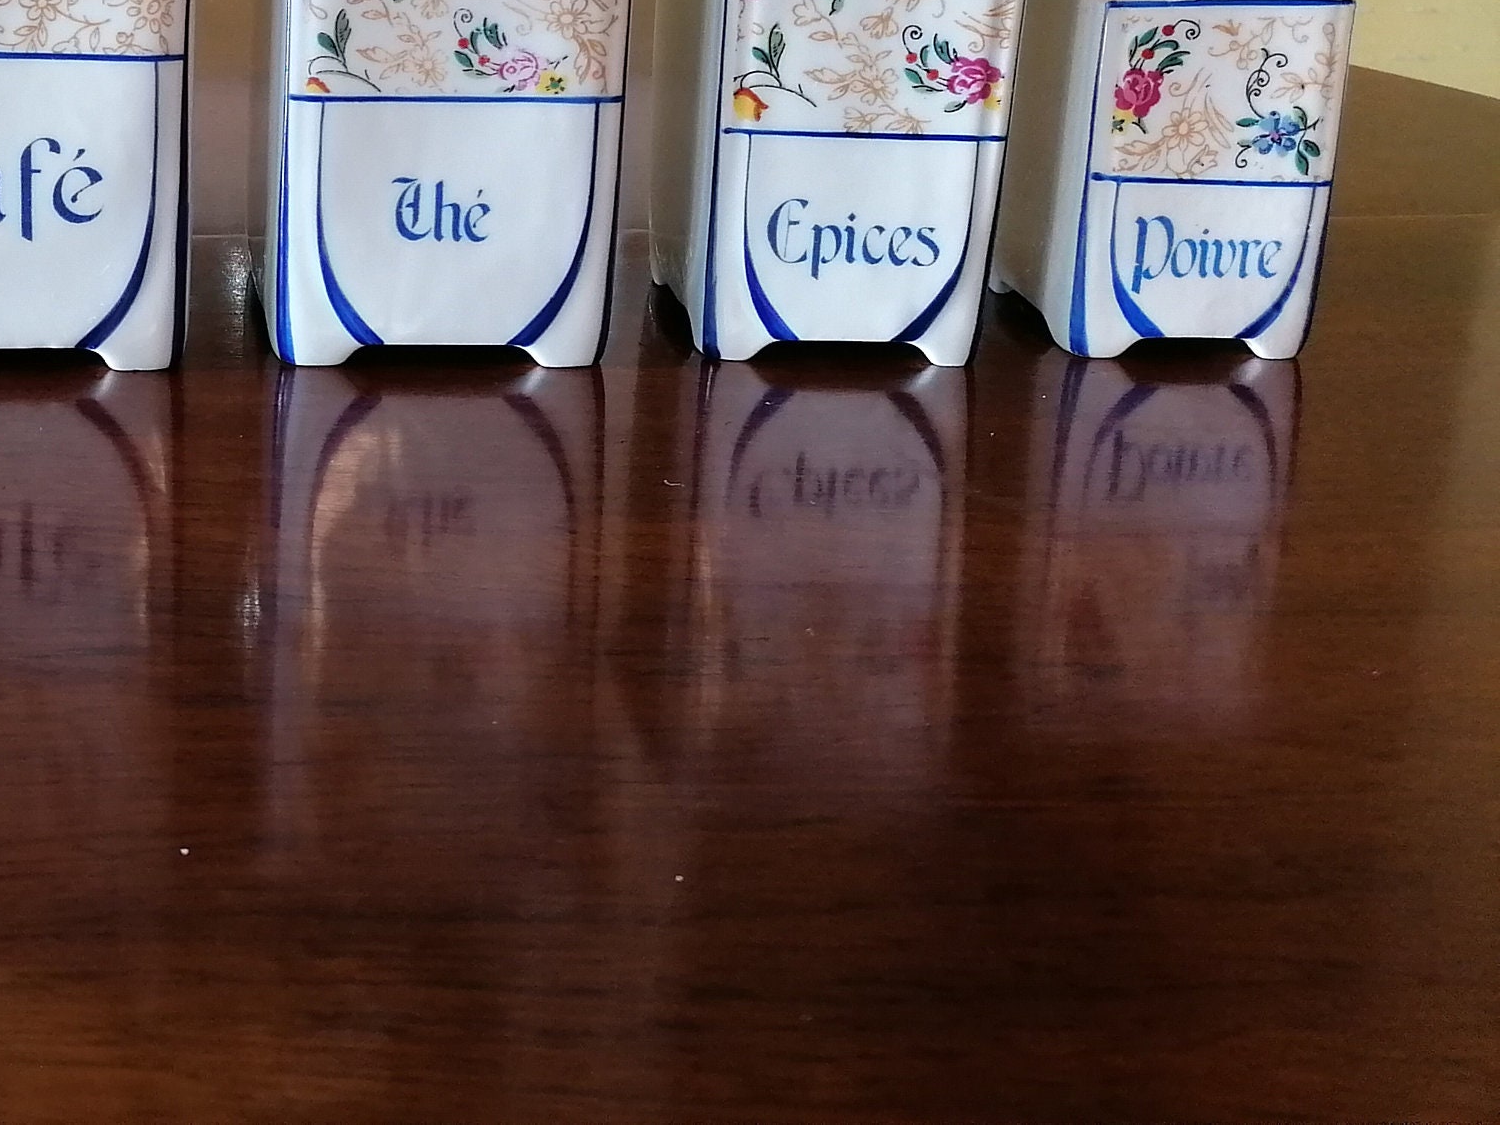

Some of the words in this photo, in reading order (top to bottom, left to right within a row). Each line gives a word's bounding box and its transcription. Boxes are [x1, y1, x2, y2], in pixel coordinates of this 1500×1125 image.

[392, 176, 492, 243] Thé
[767, 198, 940, 280] Epices
[1132, 216, 1283, 294] Poivre
